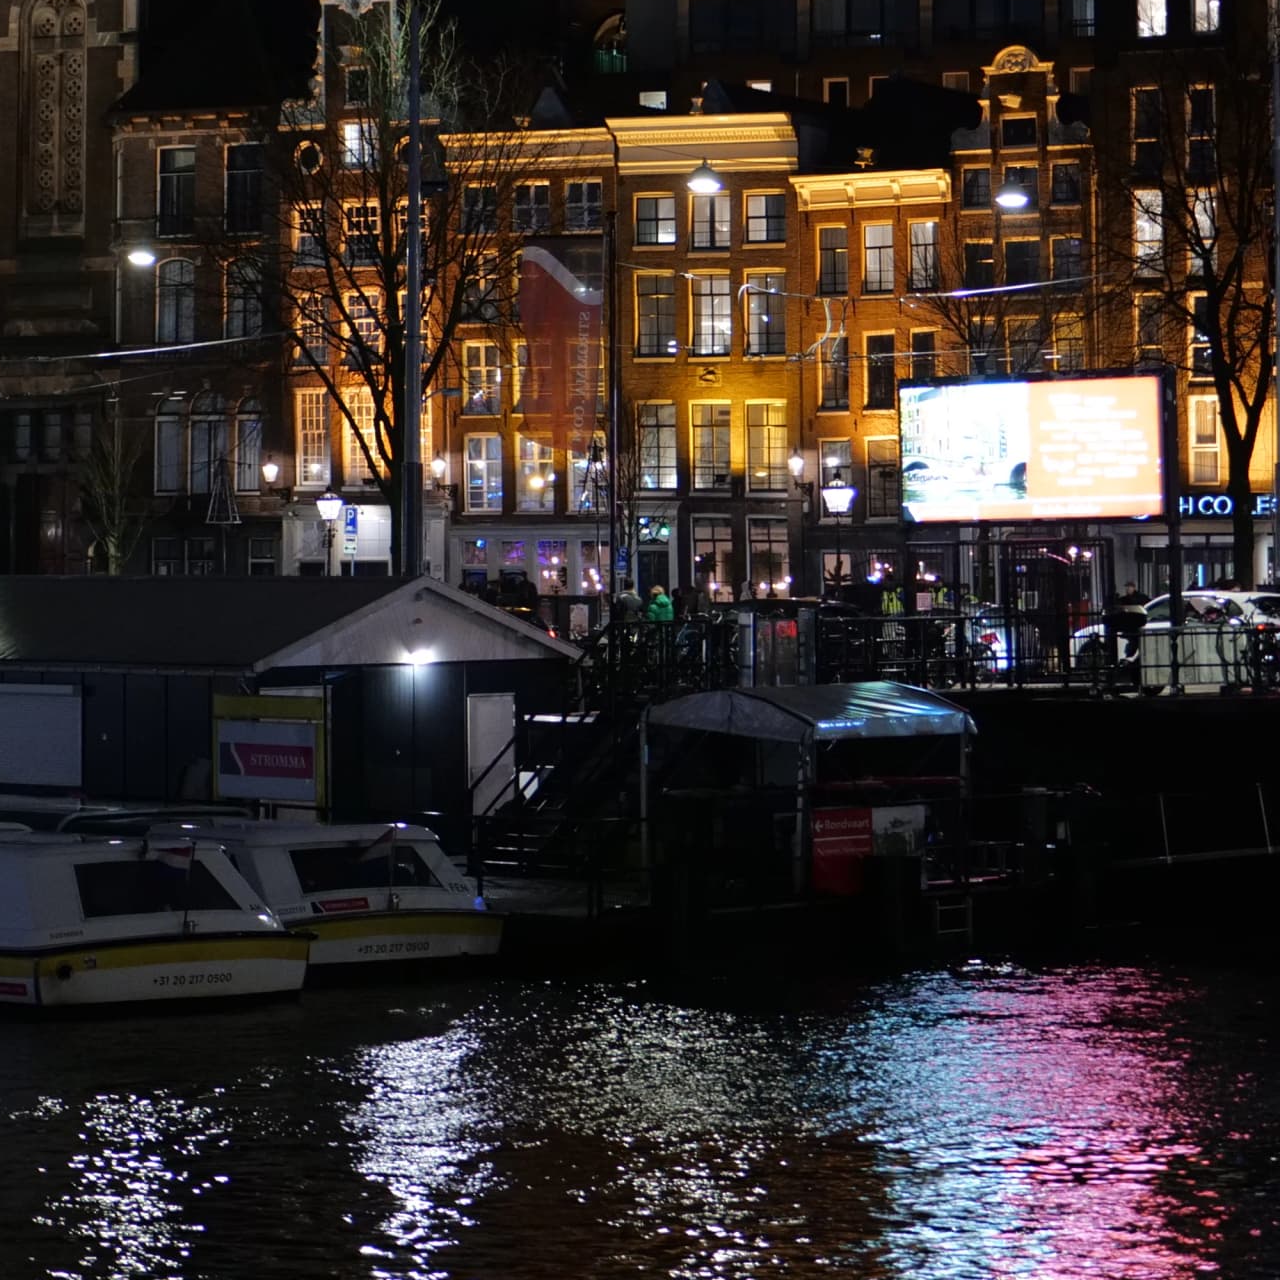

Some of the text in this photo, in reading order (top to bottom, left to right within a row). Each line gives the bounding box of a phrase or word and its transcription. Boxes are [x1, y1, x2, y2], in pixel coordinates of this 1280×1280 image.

[248, 753, 307, 769] STROMMA
[153, 972, 232, 987] +31 20 217 0500
